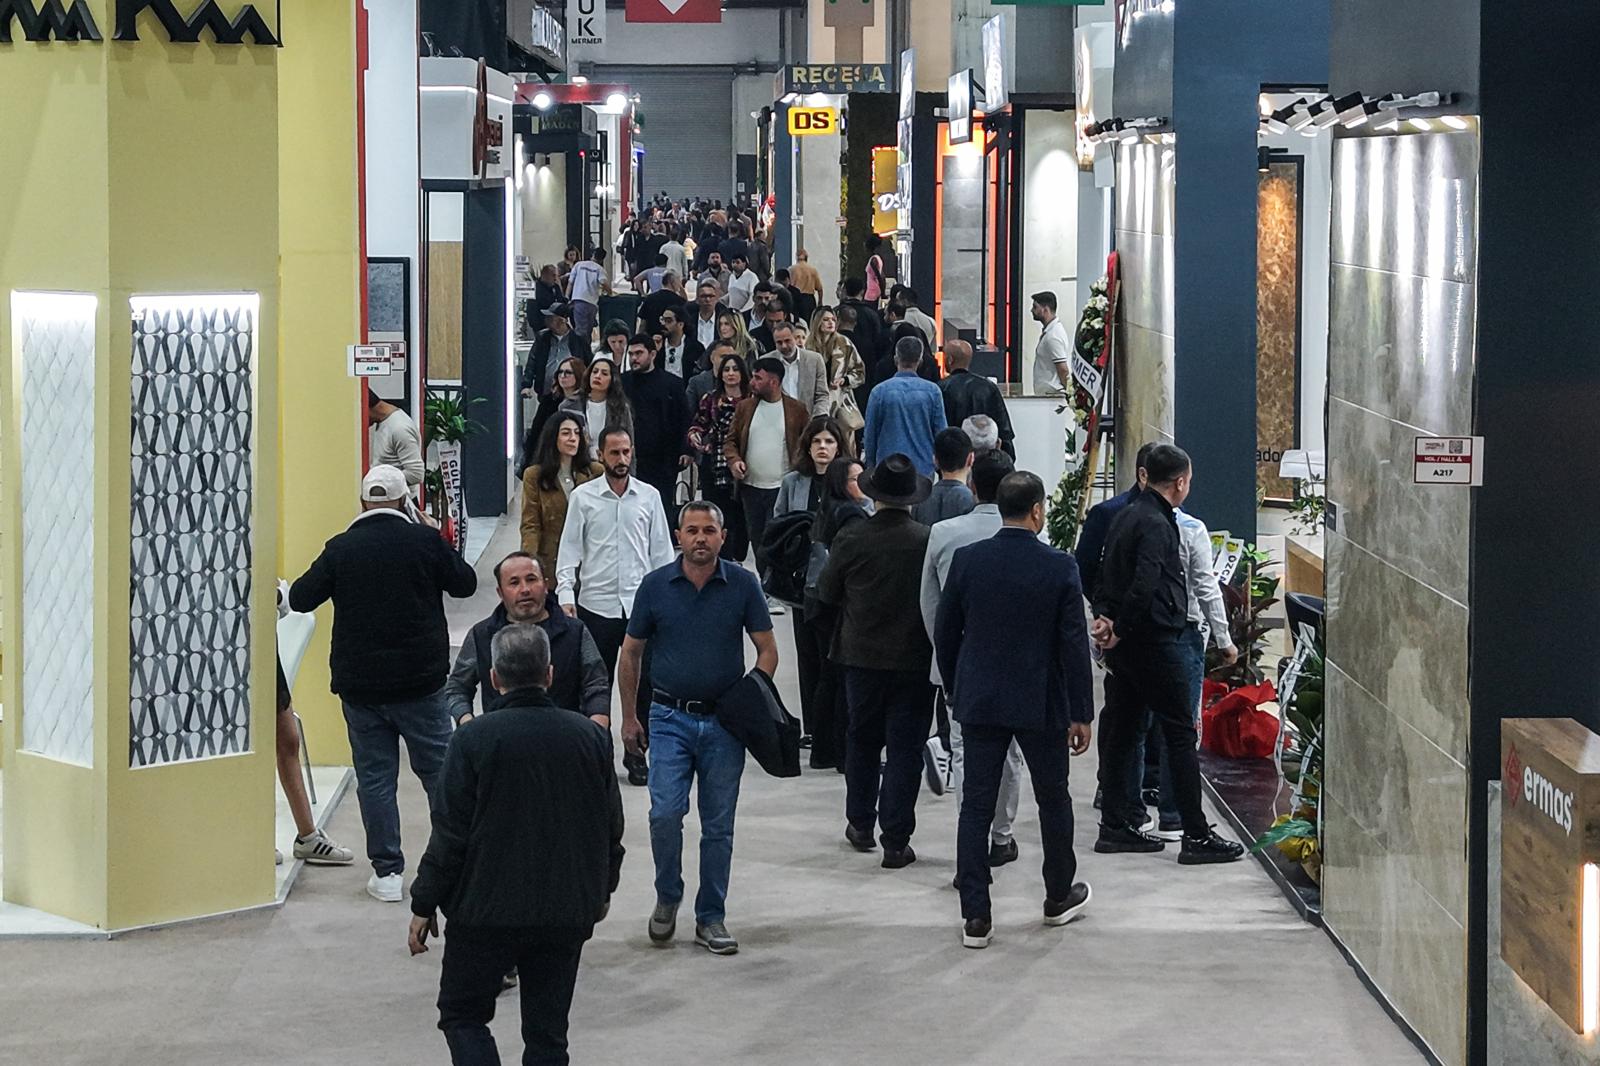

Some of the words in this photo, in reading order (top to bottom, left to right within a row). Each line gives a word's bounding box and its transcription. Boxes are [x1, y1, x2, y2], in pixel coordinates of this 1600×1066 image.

[793, 83, 886, 91] MARBE
[794, 112, 830, 129] DS
[1433, 469, 1454, 477] A217
